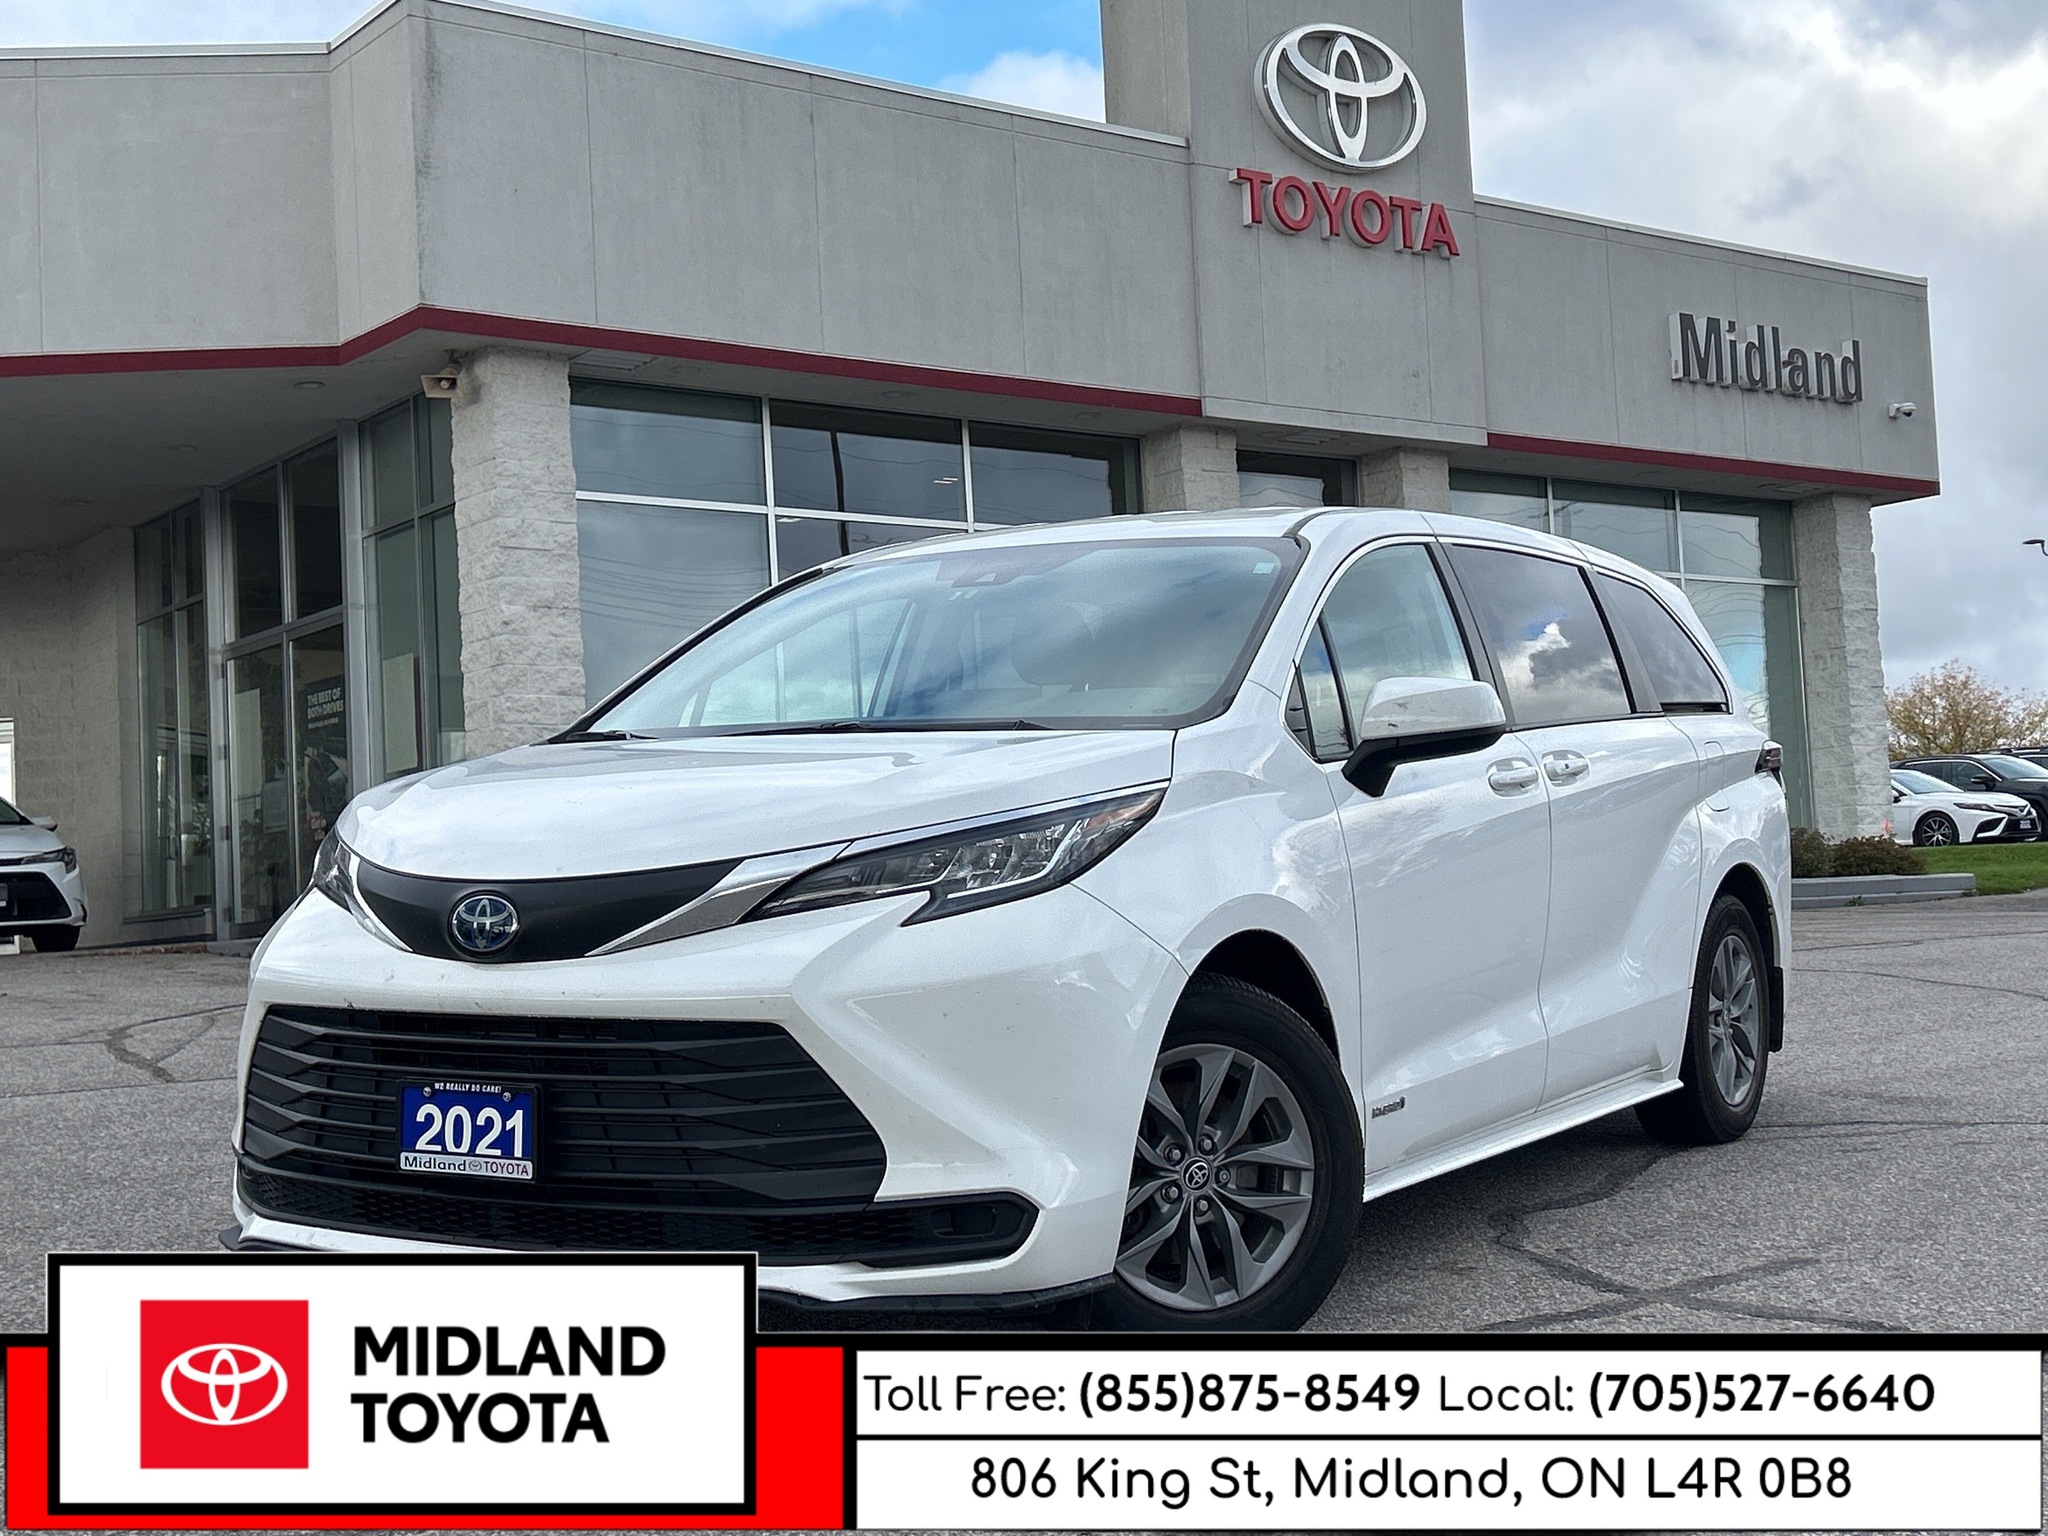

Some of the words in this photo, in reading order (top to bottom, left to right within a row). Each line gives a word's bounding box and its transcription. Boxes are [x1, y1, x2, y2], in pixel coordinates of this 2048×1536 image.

[1231, 168, 1460, 257] TOYOTA
[1673, 312, 1863, 402] Midland
[307, 692, 318, 706] THE
[318, 689, 332, 704] BEST
[332, 687, 341, 700] OF
[434, 1082, 444, 1090] WE
[446, 1083, 470, 1091] REALLY
[471, 1084, 481, 1092] DO
[482, 1085, 502, 1093] CARE!
[415, 1103, 524, 1158] 2021
[404, 1155, 466, 1171] Midland
[483, 1161, 529, 1176] TOYOTA
